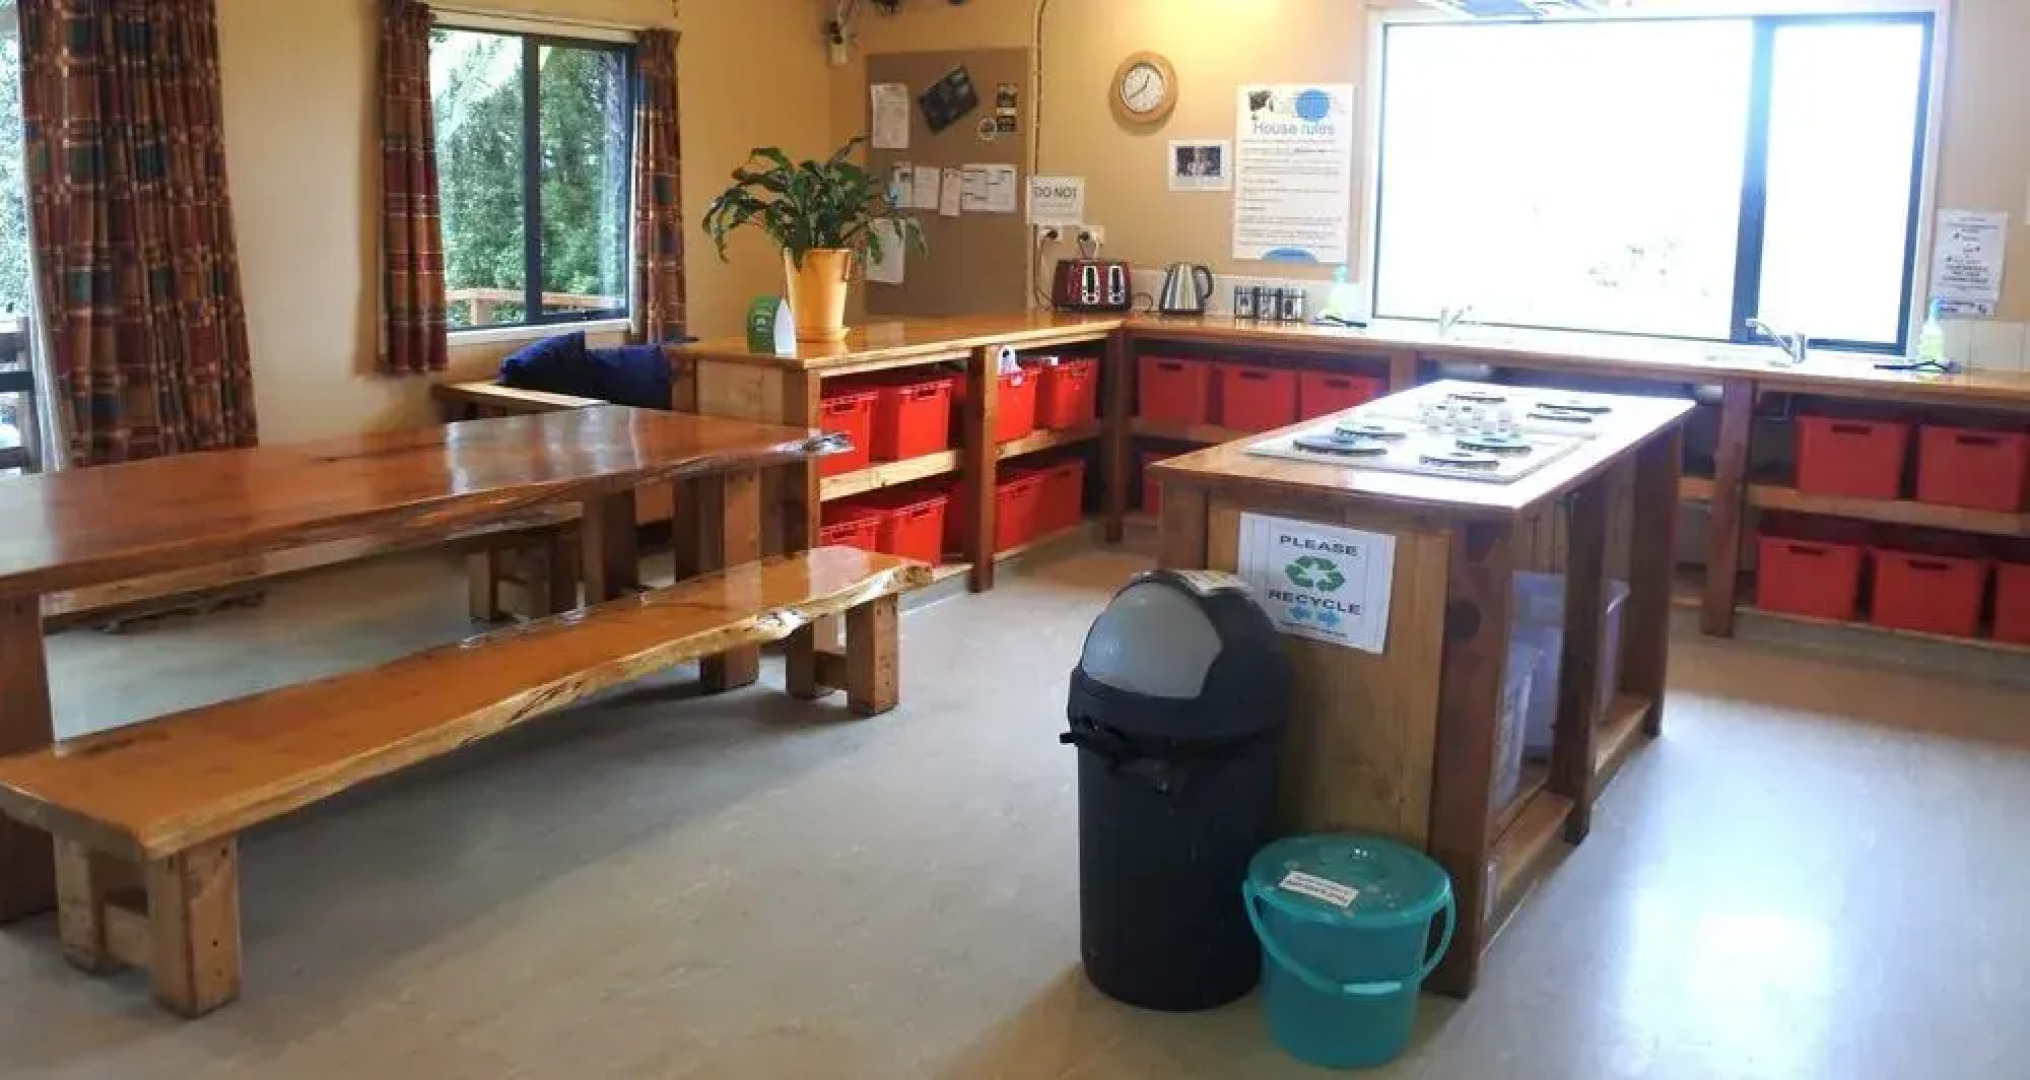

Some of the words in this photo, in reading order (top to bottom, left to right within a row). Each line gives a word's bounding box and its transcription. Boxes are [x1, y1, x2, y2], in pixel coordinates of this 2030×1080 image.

[1253, 123, 1297, 135] House
[1301, 123, 1335, 135] rules
[1033, 186, 1052, 198] DO
[1054, 186, 1077, 199] NOT
[1280, 535, 1358, 557] PLEASE
[1268, 589, 1361, 616] RECYCLE
